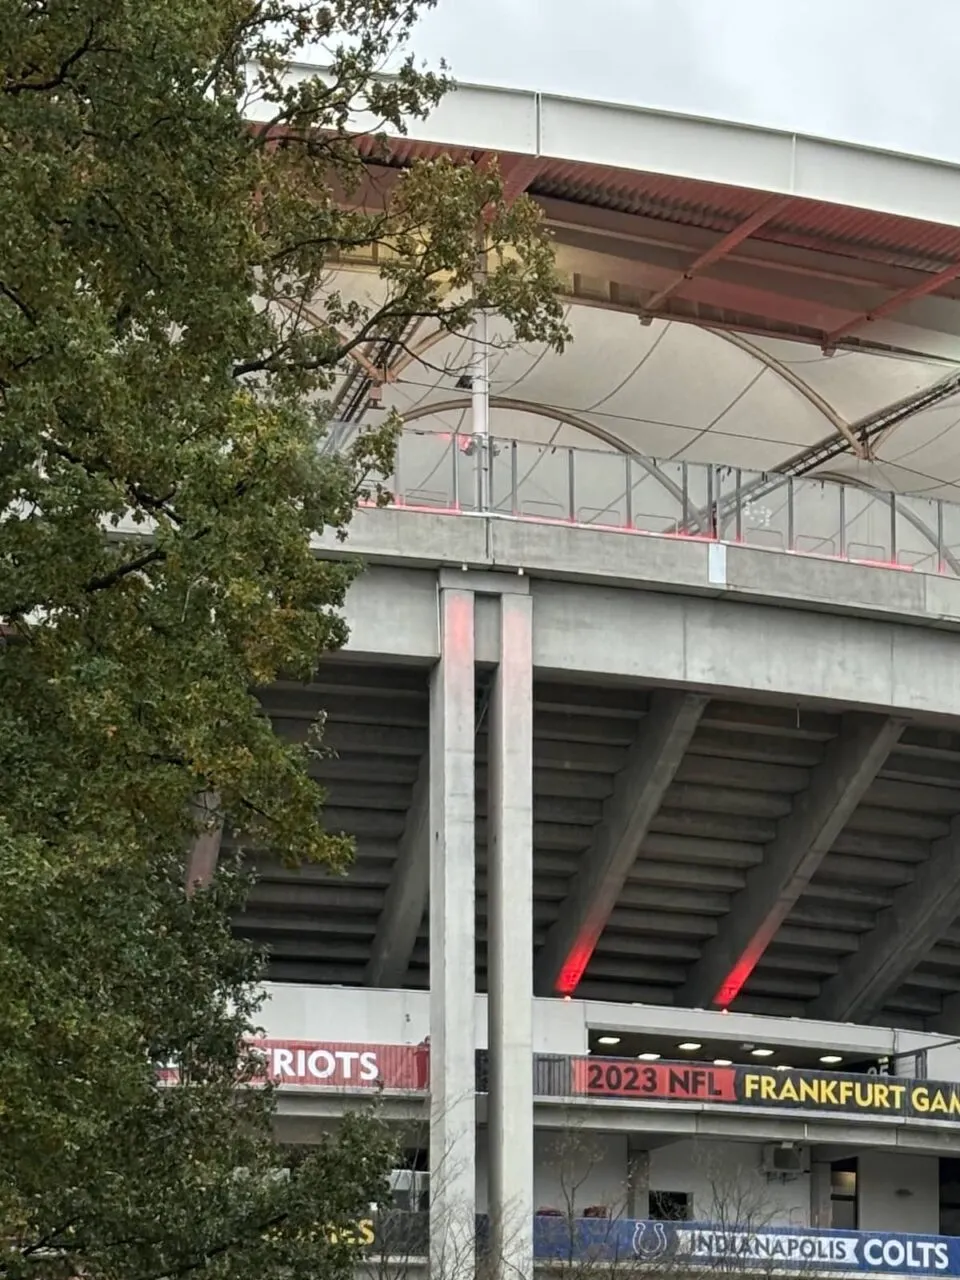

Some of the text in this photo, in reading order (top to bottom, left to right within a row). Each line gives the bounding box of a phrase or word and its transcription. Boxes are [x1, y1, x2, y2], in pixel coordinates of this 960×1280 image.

[588, 1064, 657, 1093] 2023
[669, 1070, 722, 1096] NFL
[745, 1074, 906, 1109] FRANKFURT
[690, 1230, 949, 1269] INDIANAPOLIS COLTS
